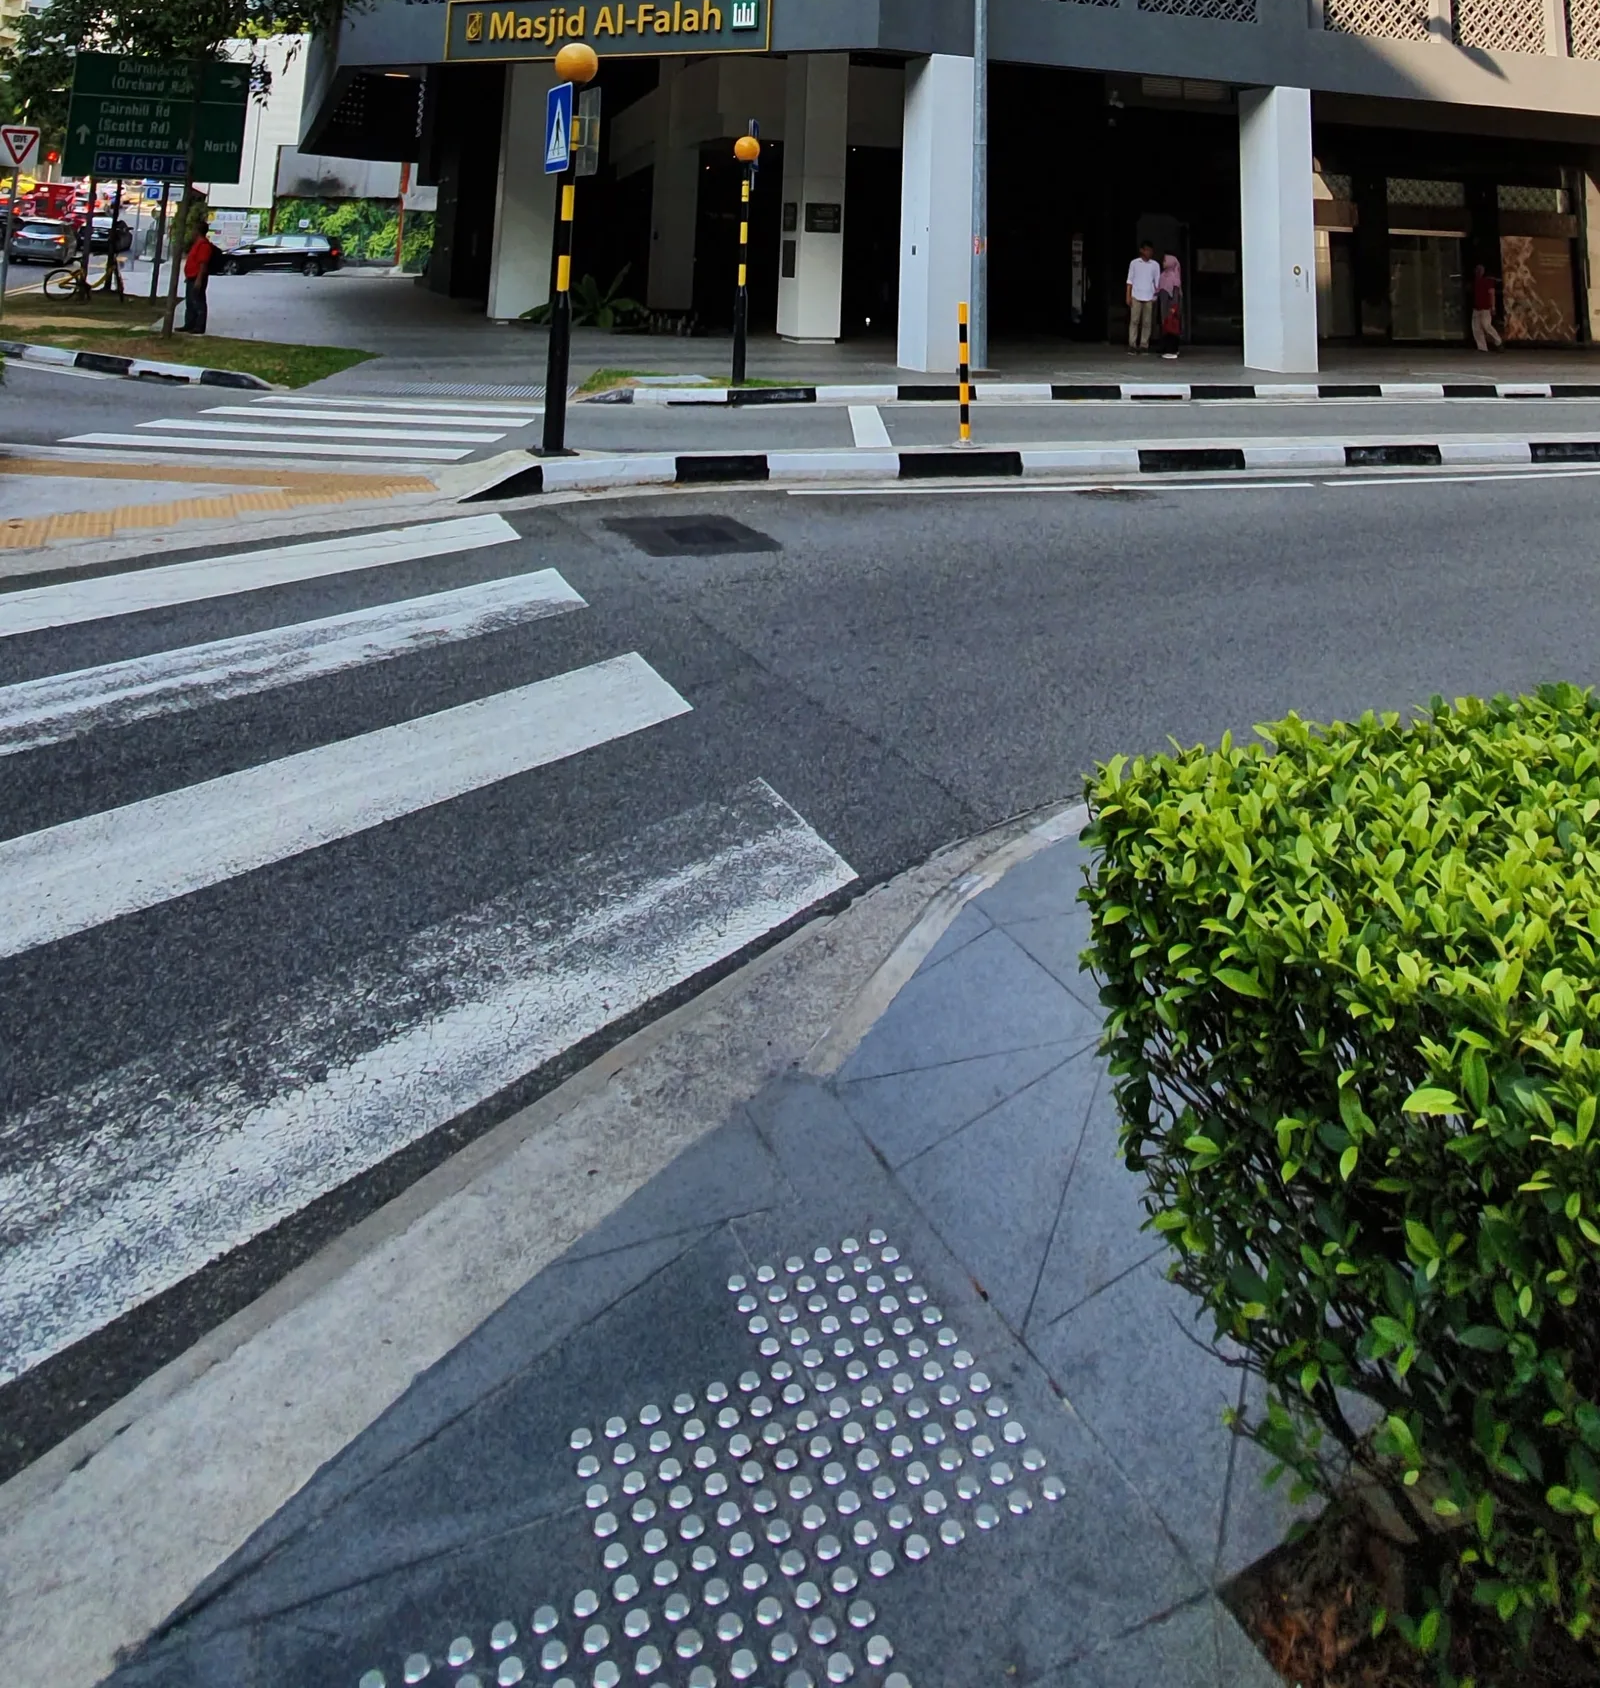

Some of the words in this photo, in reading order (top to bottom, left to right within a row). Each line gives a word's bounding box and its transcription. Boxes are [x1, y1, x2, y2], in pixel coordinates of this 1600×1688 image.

[489, 6, 585, 45] Masjid
[594, 0, 722, 36] Al-Falah
[111, 74, 165, 92] (Orchard
[100, 101, 150, 116] Cairnhill
[155, 105, 170, 118] Rd
[98, 117, 144, 133] (Scotts
[150, 120, 170, 135] Rd)
[96, 134, 169, 150] Clemenceau
[204, 140, 238, 153] North
[97, 156, 124, 170] CTE
[130, 157, 164, 172] (SLE)
